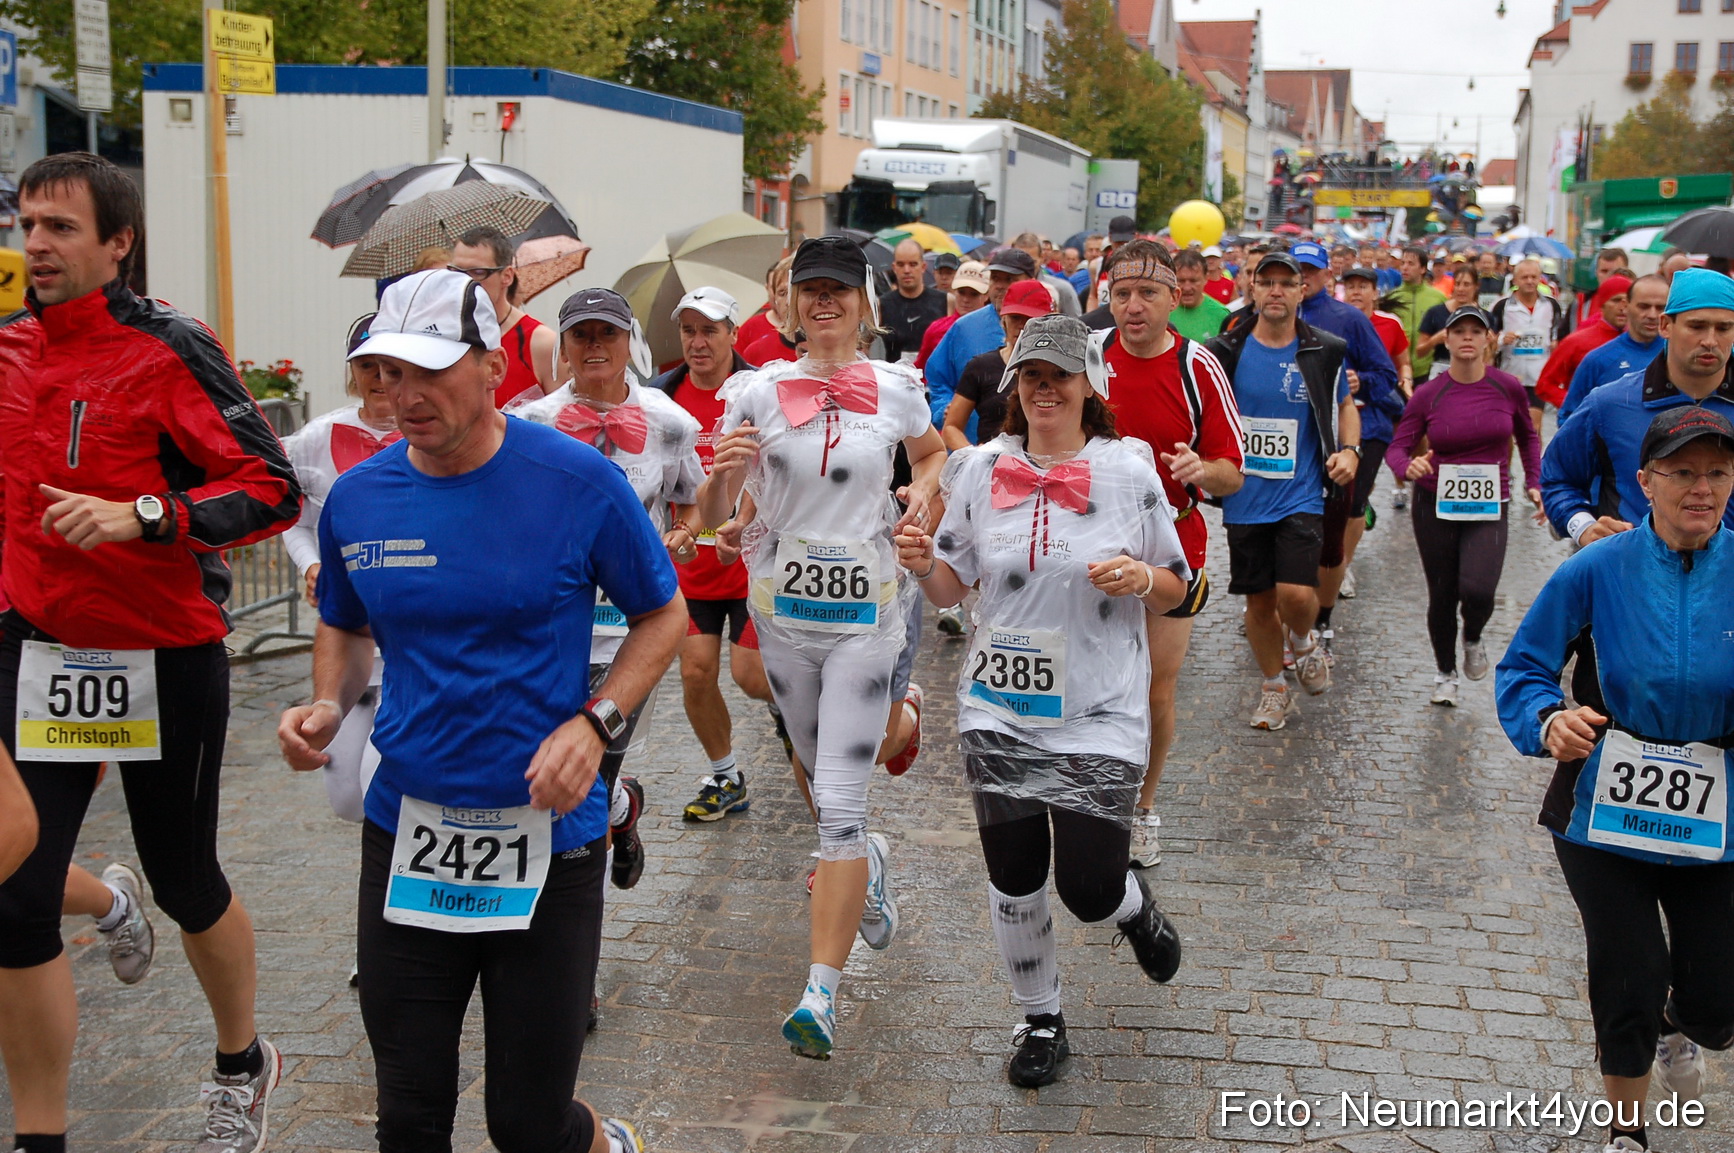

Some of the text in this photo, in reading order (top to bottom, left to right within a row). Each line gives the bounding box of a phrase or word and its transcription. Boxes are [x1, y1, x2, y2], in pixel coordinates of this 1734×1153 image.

[215, 34, 262, 56] betreuung
[884, 161, 946, 174] BOCK
[1351, 193, 1391, 204] START
[1444, 480, 1494, 500] 2938
[807, 545, 847, 556] BOCK
[783, 561, 870, 600] 2386
[791, 602, 859, 621] Alexandra
[991, 633, 1030, 646] BOCK
[63, 651, 113, 664] BOCK
[972, 650, 1055, 692] 2385
[48, 674, 130, 719] 509
[46, 727, 131, 747] Christoph
[1641, 743, 1694, 759] BOCK
[1609, 761, 1716, 815] 3287
[441, 806, 502, 823] BOCK
[1622, 813, 1693, 840] Mariane
[409, 824, 529, 883] 2421
[561, 849, 591, 860] adidas
[428, 887, 504, 914] Norbert
